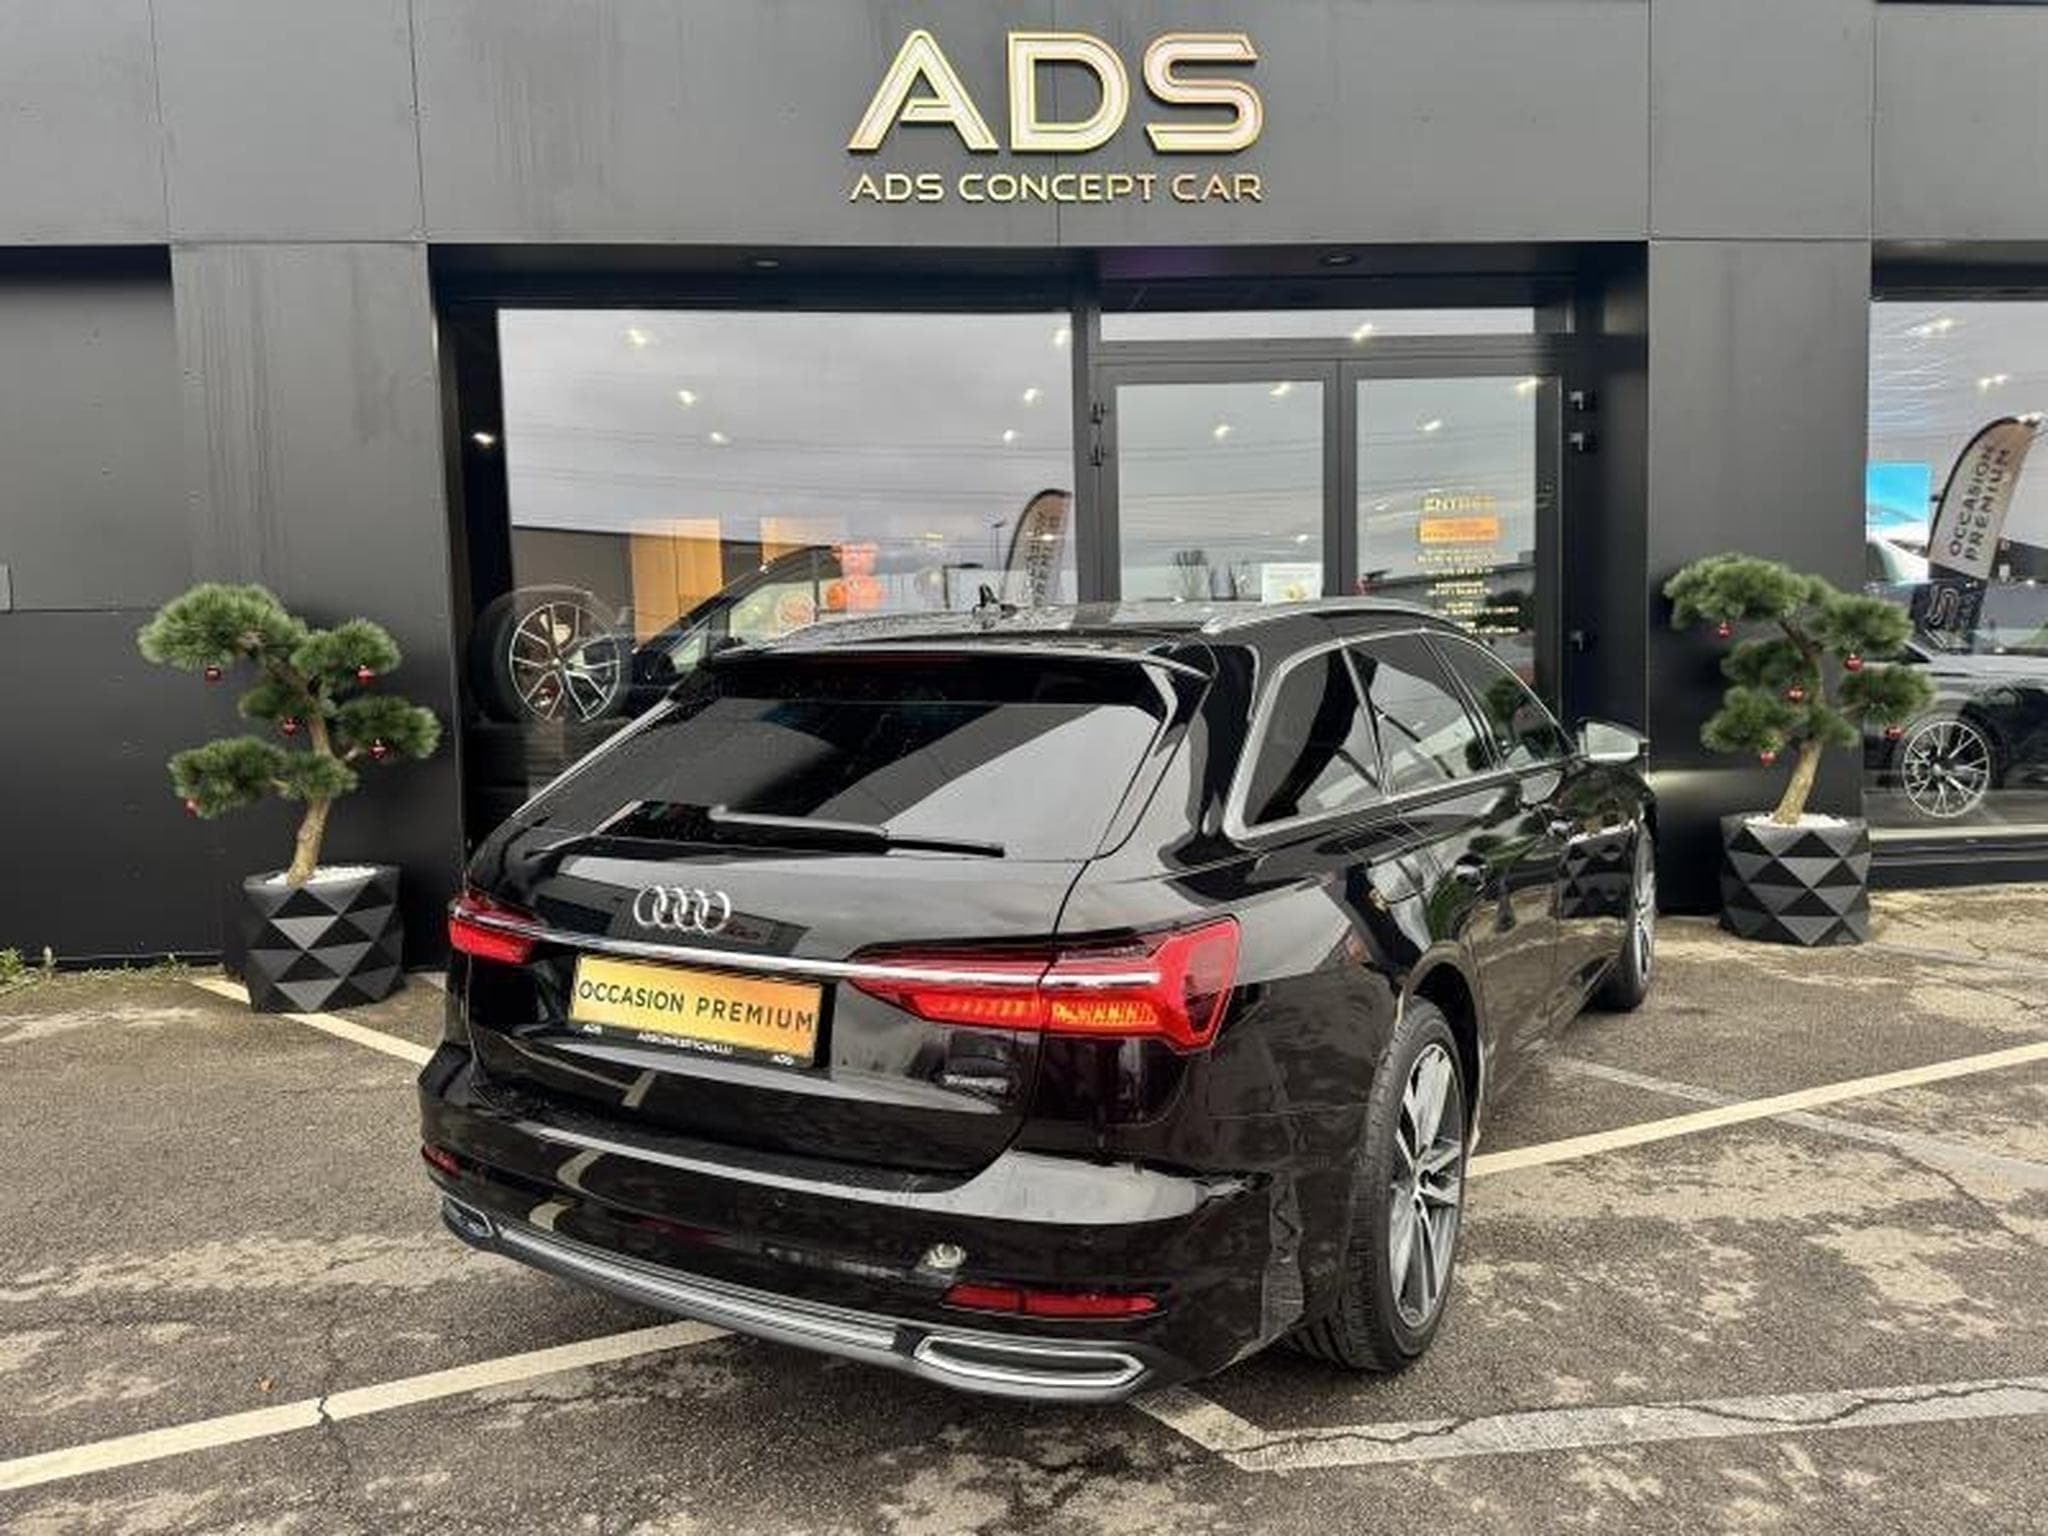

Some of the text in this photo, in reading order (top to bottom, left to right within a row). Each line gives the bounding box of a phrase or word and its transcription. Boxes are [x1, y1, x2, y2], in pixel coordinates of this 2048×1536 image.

[847, 29, 1264, 152] ADS
[850, 173, 1263, 202] ADS CONCEPT CAR
[1950, 446, 1994, 557] OCCASION
[1965, 449, 2011, 561] PREMIUM
[578, 979, 813, 1032] OCCASION PREMIUM
